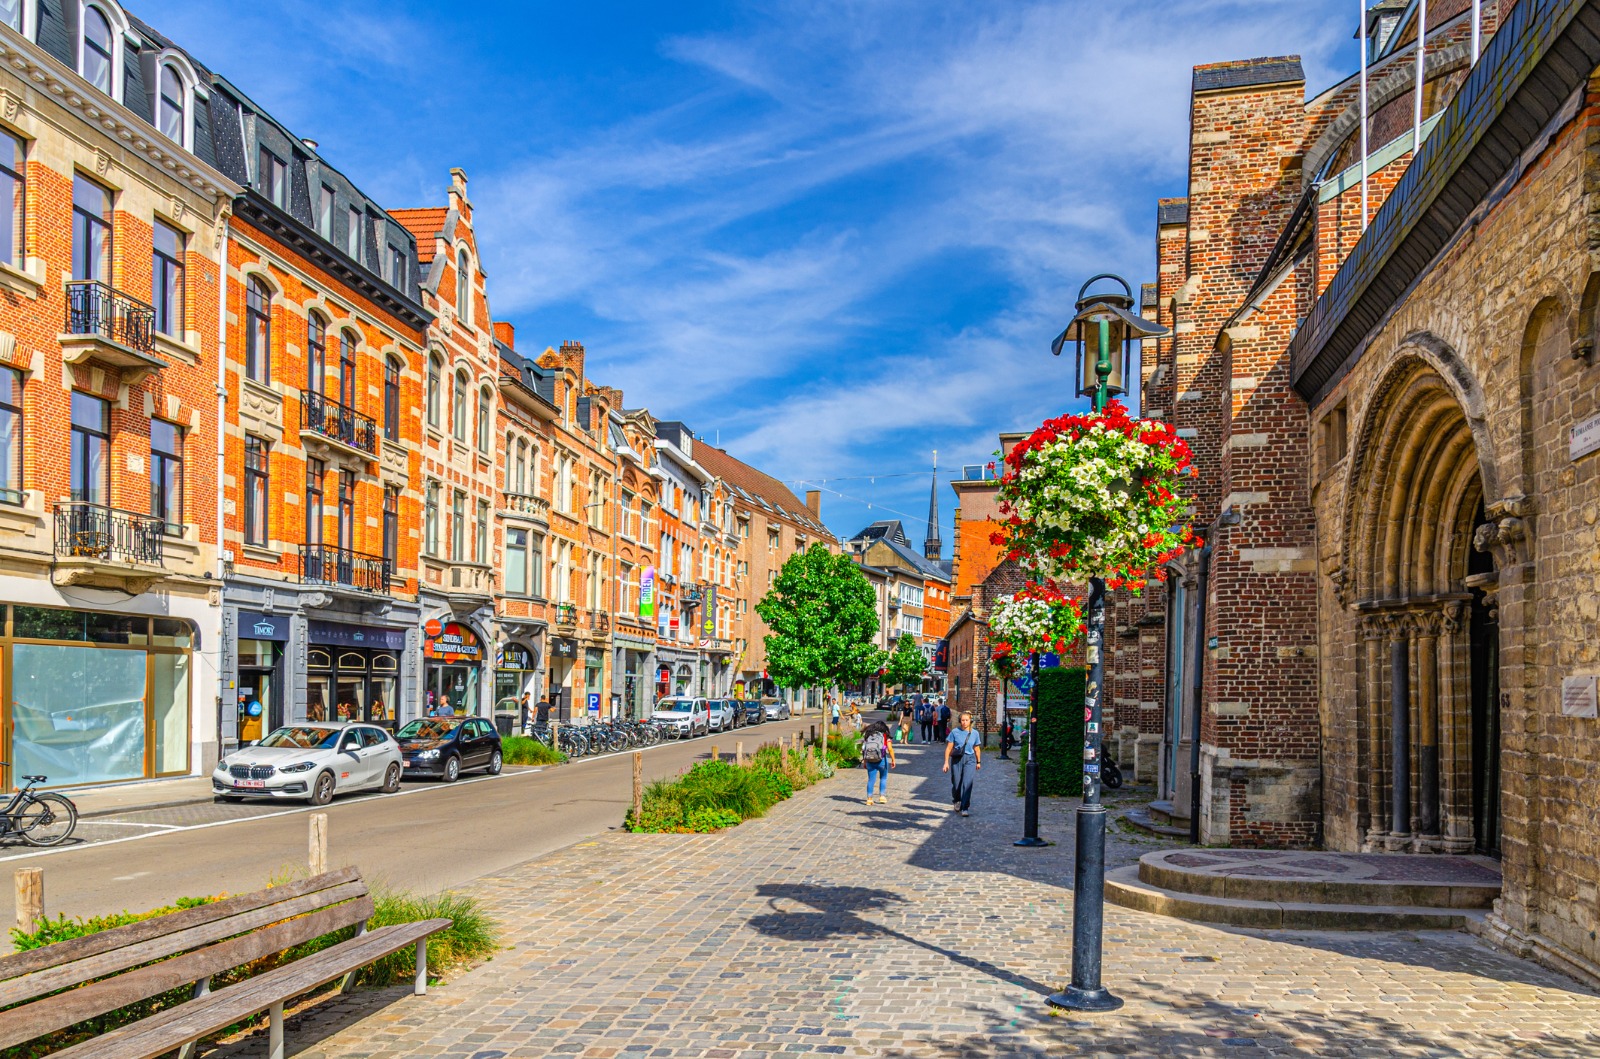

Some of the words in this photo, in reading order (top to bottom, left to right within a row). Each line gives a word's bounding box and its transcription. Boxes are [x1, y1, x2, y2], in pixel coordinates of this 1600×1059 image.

[642, 579, 652, 602] GROEN
[590, 696, 599, 708] P
[1501, 693, 1510, 708] 63
